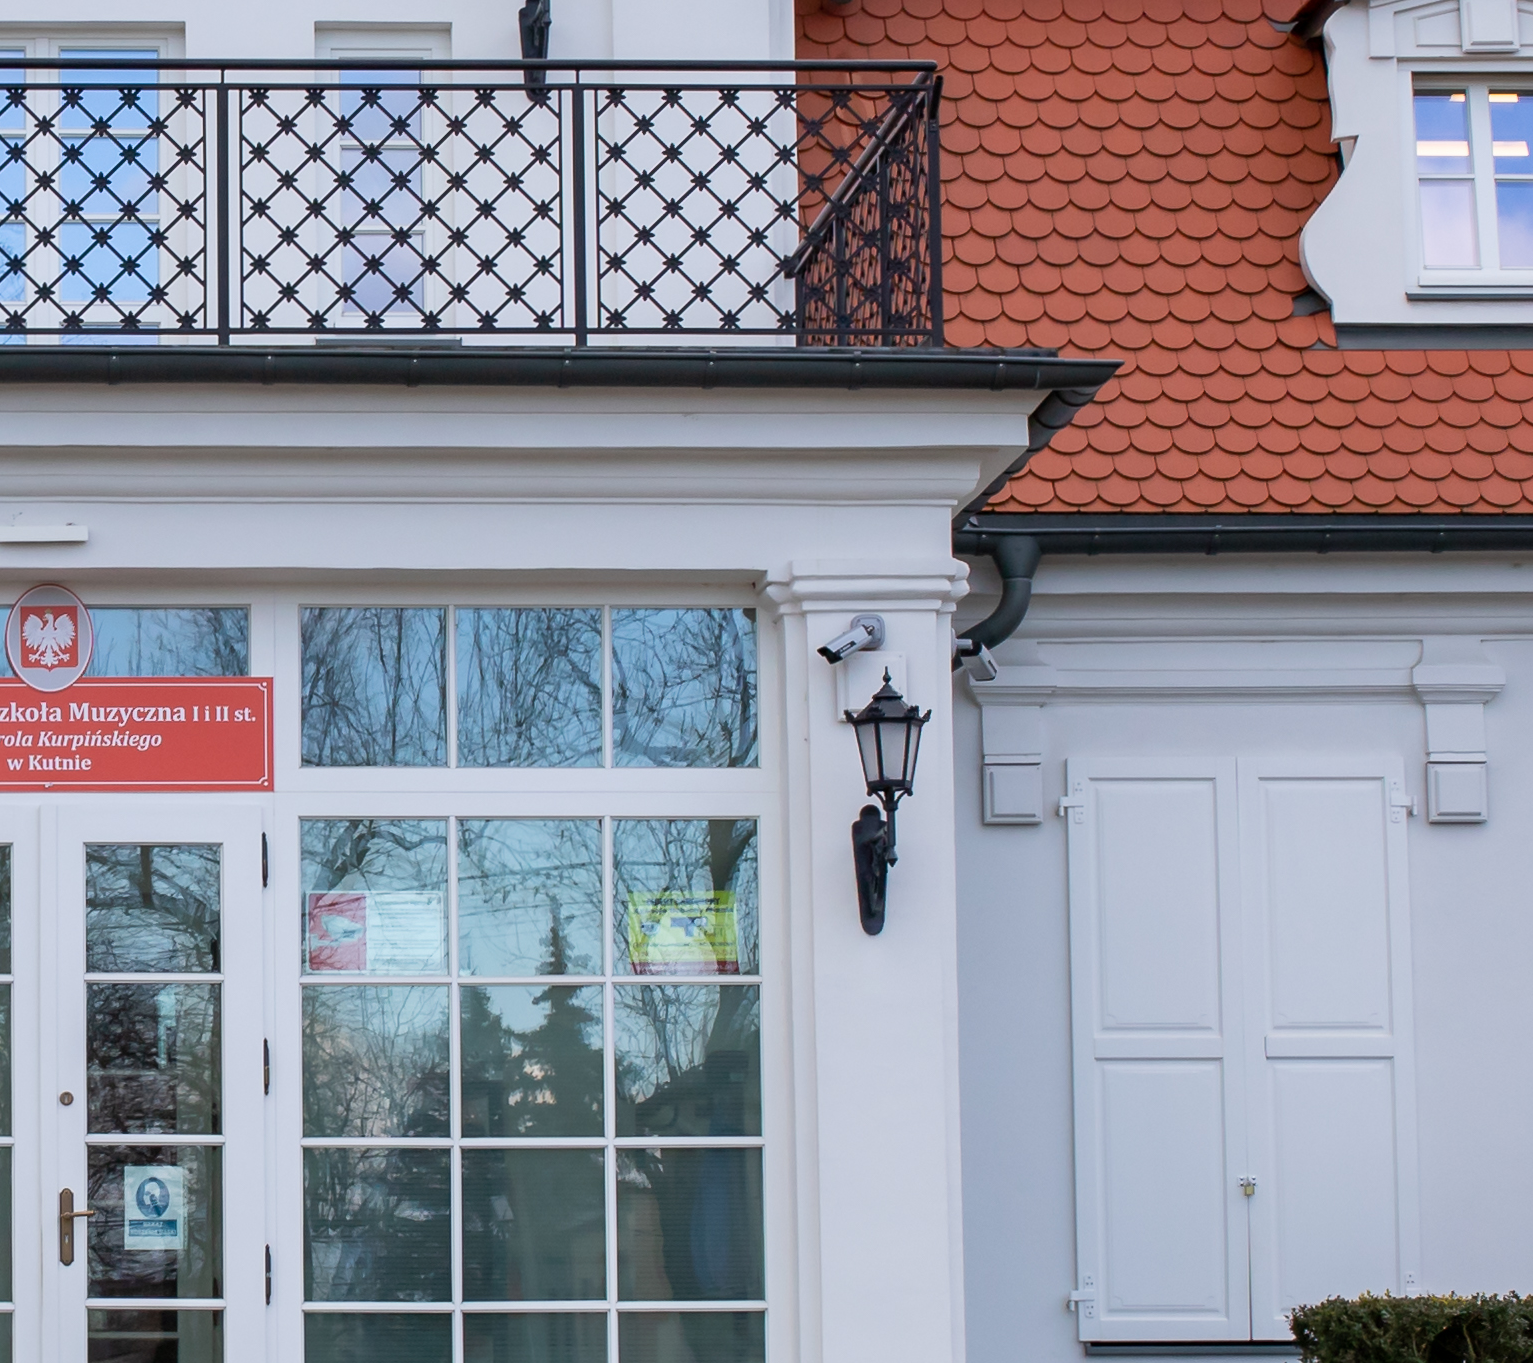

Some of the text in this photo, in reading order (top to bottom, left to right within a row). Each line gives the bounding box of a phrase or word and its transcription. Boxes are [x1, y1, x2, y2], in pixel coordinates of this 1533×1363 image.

[68, 702, 187, 727] Muzyczna
[192, 705, 199, 722] I
[204, 705, 211, 722] i
[215, 705, 229, 722] II
[234, 707, 257, 722] st.
[36, 729, 163, 752] Kurpińskiego
[6, 754, 93, 771] w Kutnie
